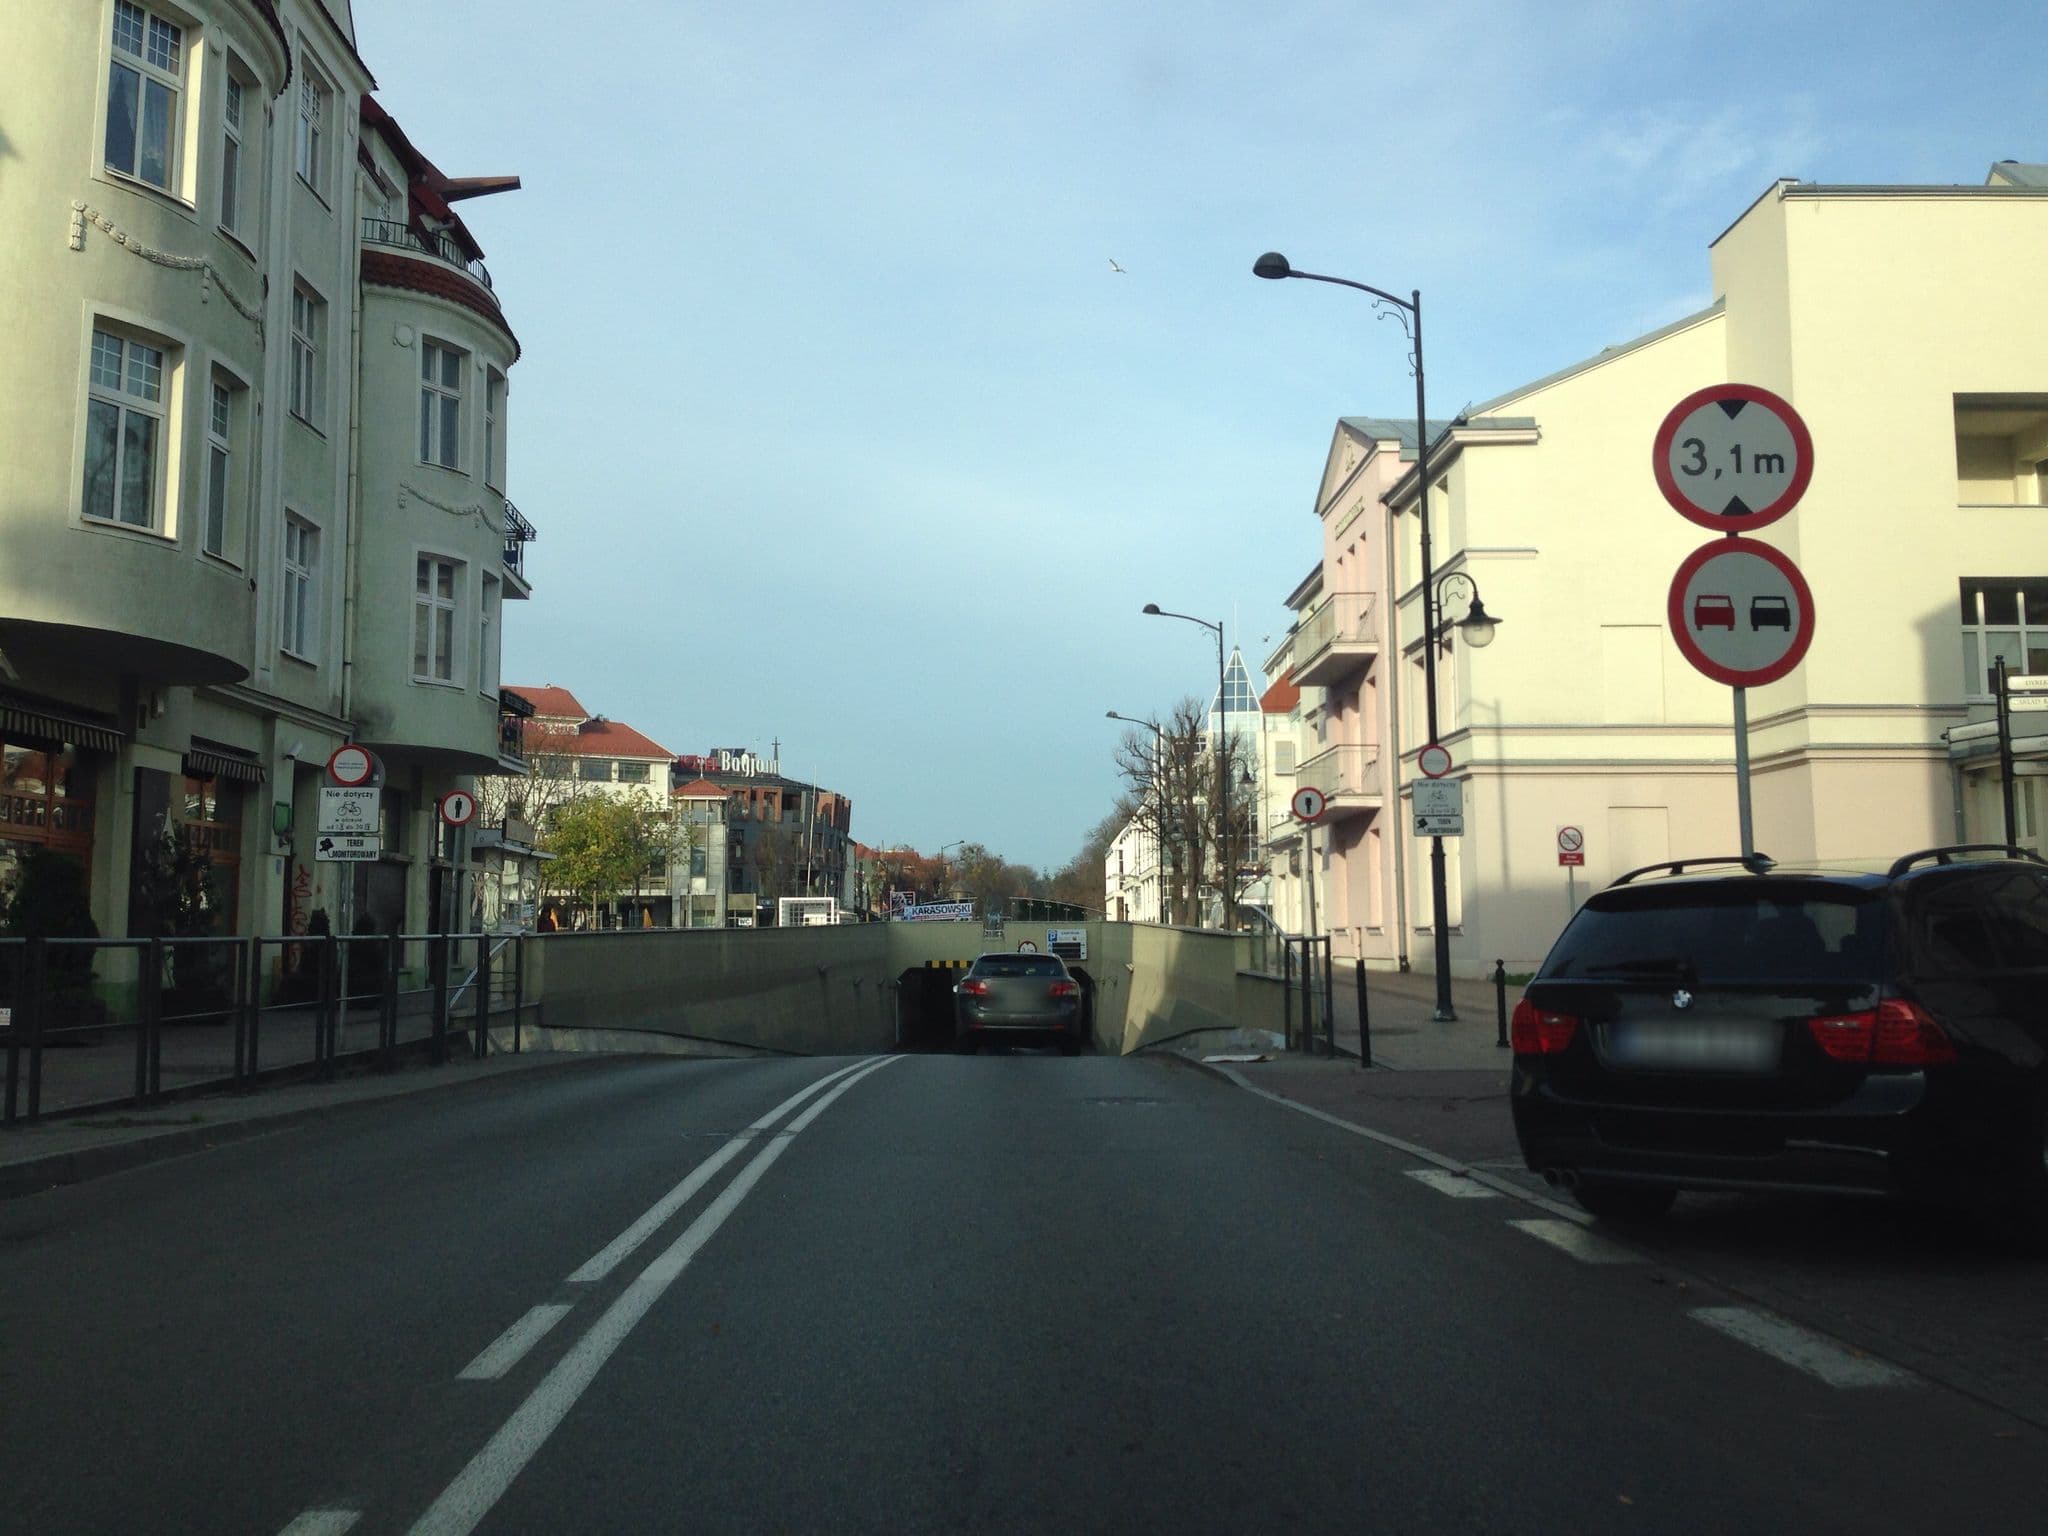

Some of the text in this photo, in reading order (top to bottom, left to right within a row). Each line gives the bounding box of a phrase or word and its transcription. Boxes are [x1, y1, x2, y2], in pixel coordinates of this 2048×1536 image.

[326, 790, 374, 799] Nie dotyczy
[331, 850, 377, 858] MONITOROWANY
[912, 904, 971, 915] KARASOWSKI
